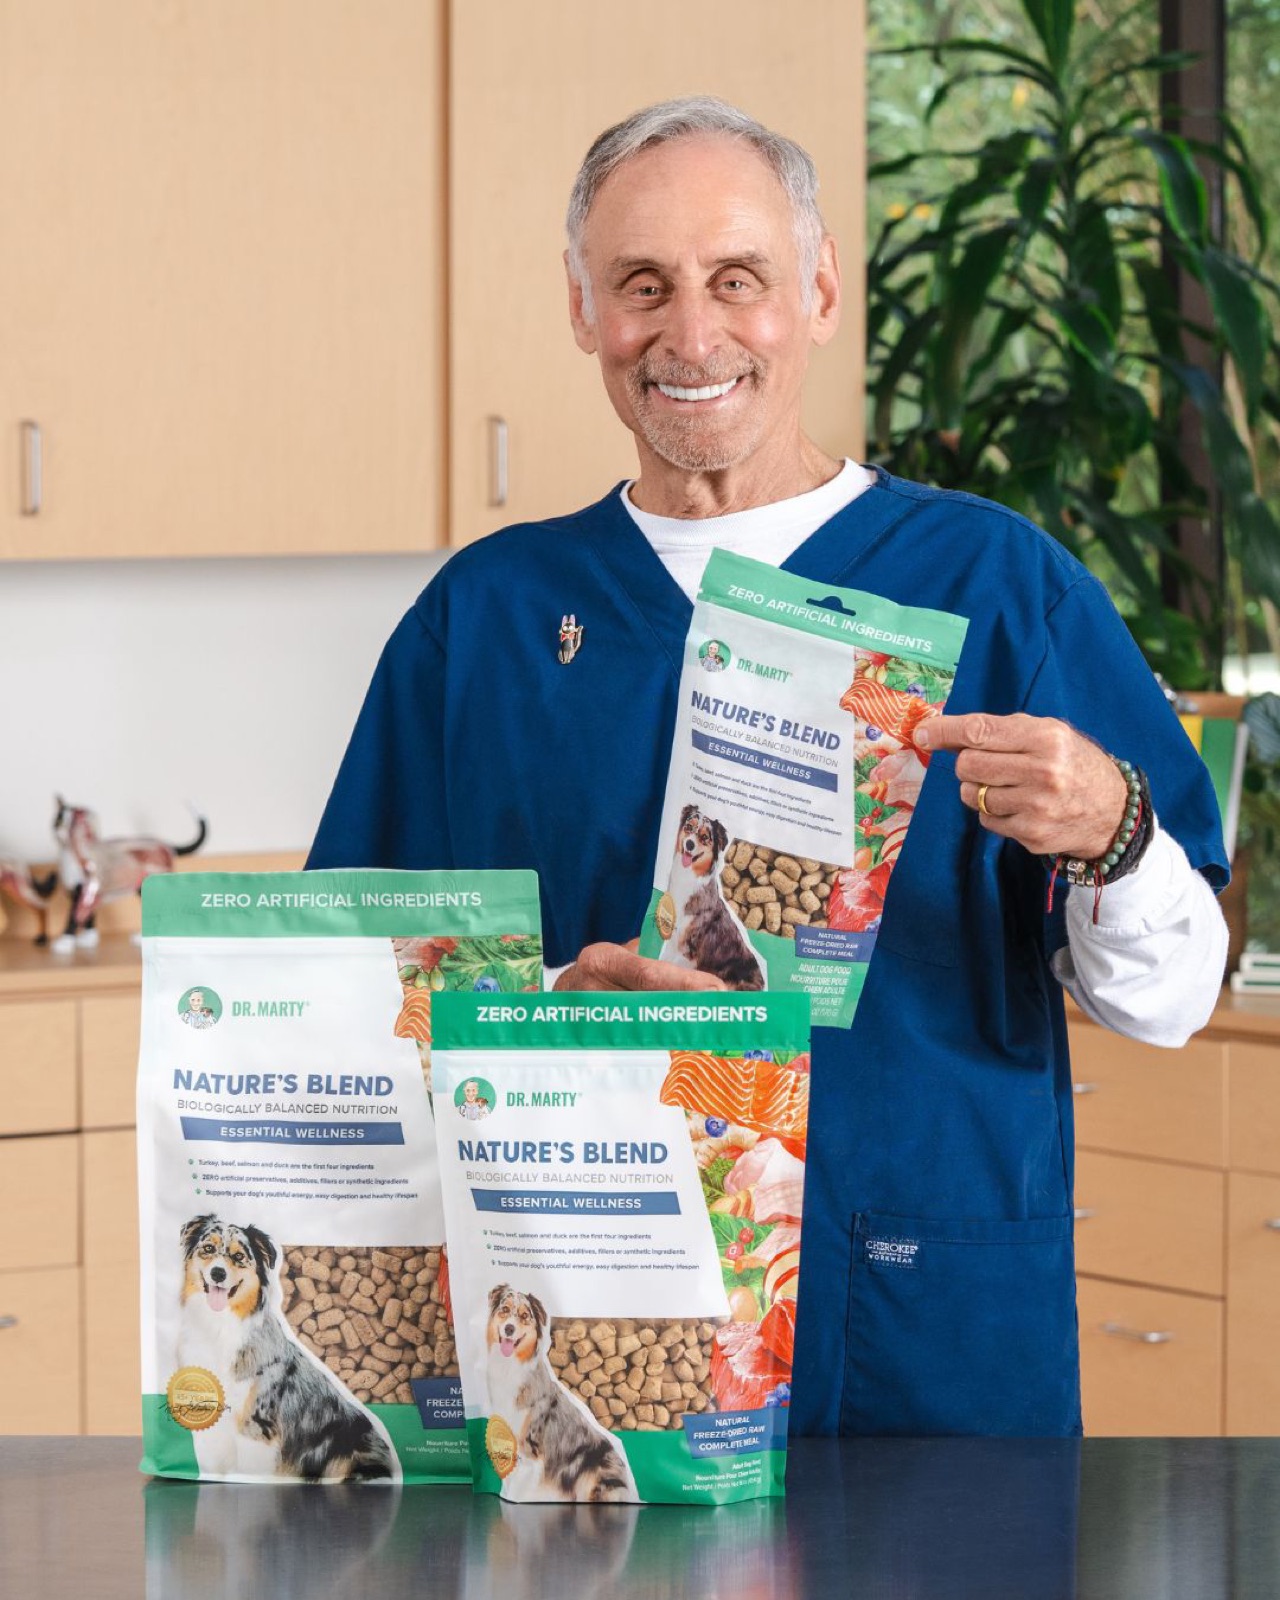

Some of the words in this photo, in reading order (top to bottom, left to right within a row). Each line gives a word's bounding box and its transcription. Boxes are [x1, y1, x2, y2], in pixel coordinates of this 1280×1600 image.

[727, 584, 765, 604] ZERO
[766, 598, 837, 628] ARTIFICIAL
[841, 618, 933, 652] INGREDIENTS
[691, 690, 776, 733] NATURE'S
[779, 718, 841, 751] BLEND
[692, 715, 743, 741] BIOLOGICALLY
[745, 733, 791, 756] BALANCED
[792, 745, 839, 768] NUTRITION
[708, 742, 759, 766] ESSENTIAL
[762, 758, 812, 780] WELLNESS
[201, 893, 251, 908] ZERO
[256, 893, 357, 907] ARTIFICIAL
[361, 891, 482, 907] INGREDIENTS
[818, 932, 847, 941] NATURAL
[802, 947, 837, 956] COMPLETE
[477, 1006, 527, 1023] ZERO
[532, 1006, 634, 1023] ARTIFICIAL
[639, 1006, 768, 1023] INGREDIENTS
[173, 1069, 299, 1096] NATURE'S
[307, 1074, 394, 1097] BLEND
[177, 1100, 262, 1115] BIOLOGICALLY
[265, 1102, 329, 1115] BALANCED
[332, 1104, 398, 1116] NUTRITION
[220, 1126, 291, 1139] ESSENTIAL
[295, 1127, 365, 1140] WELLNESS
[457, 1140, 575, 1164] NATURE'S
[583, 1142, 668, 1165] BLEND
[340, 1163, 374, 1171] ingredients
[466, 1171, 538, 1184] BIOLOGICALLY
[542, 1172, 606, 1184] BALANCED
[609, 1173, 673, 1184] NUTRITION
[500, 1197, 570, 1209] ESSENTIAL
[573, 1198, 642, 1209] WELLNESS
[866, 1240, 916, 1255] CHEROKEE
[868, 1252, 913, 1264] WORKWEAR
[427, 1398, 463, 1407] FREEZE
[433, 1410, 463, 1419] COMP
[715, 1416, 750, 1427] NATURAL
[693, 1427, 747, 1440] FREEZE-DRIED
[748, 1425, 766, 1433] RAW
[698, 1439, 743, 1451] COMPLETE
[743, 1437, 759, 1446] MEAL
